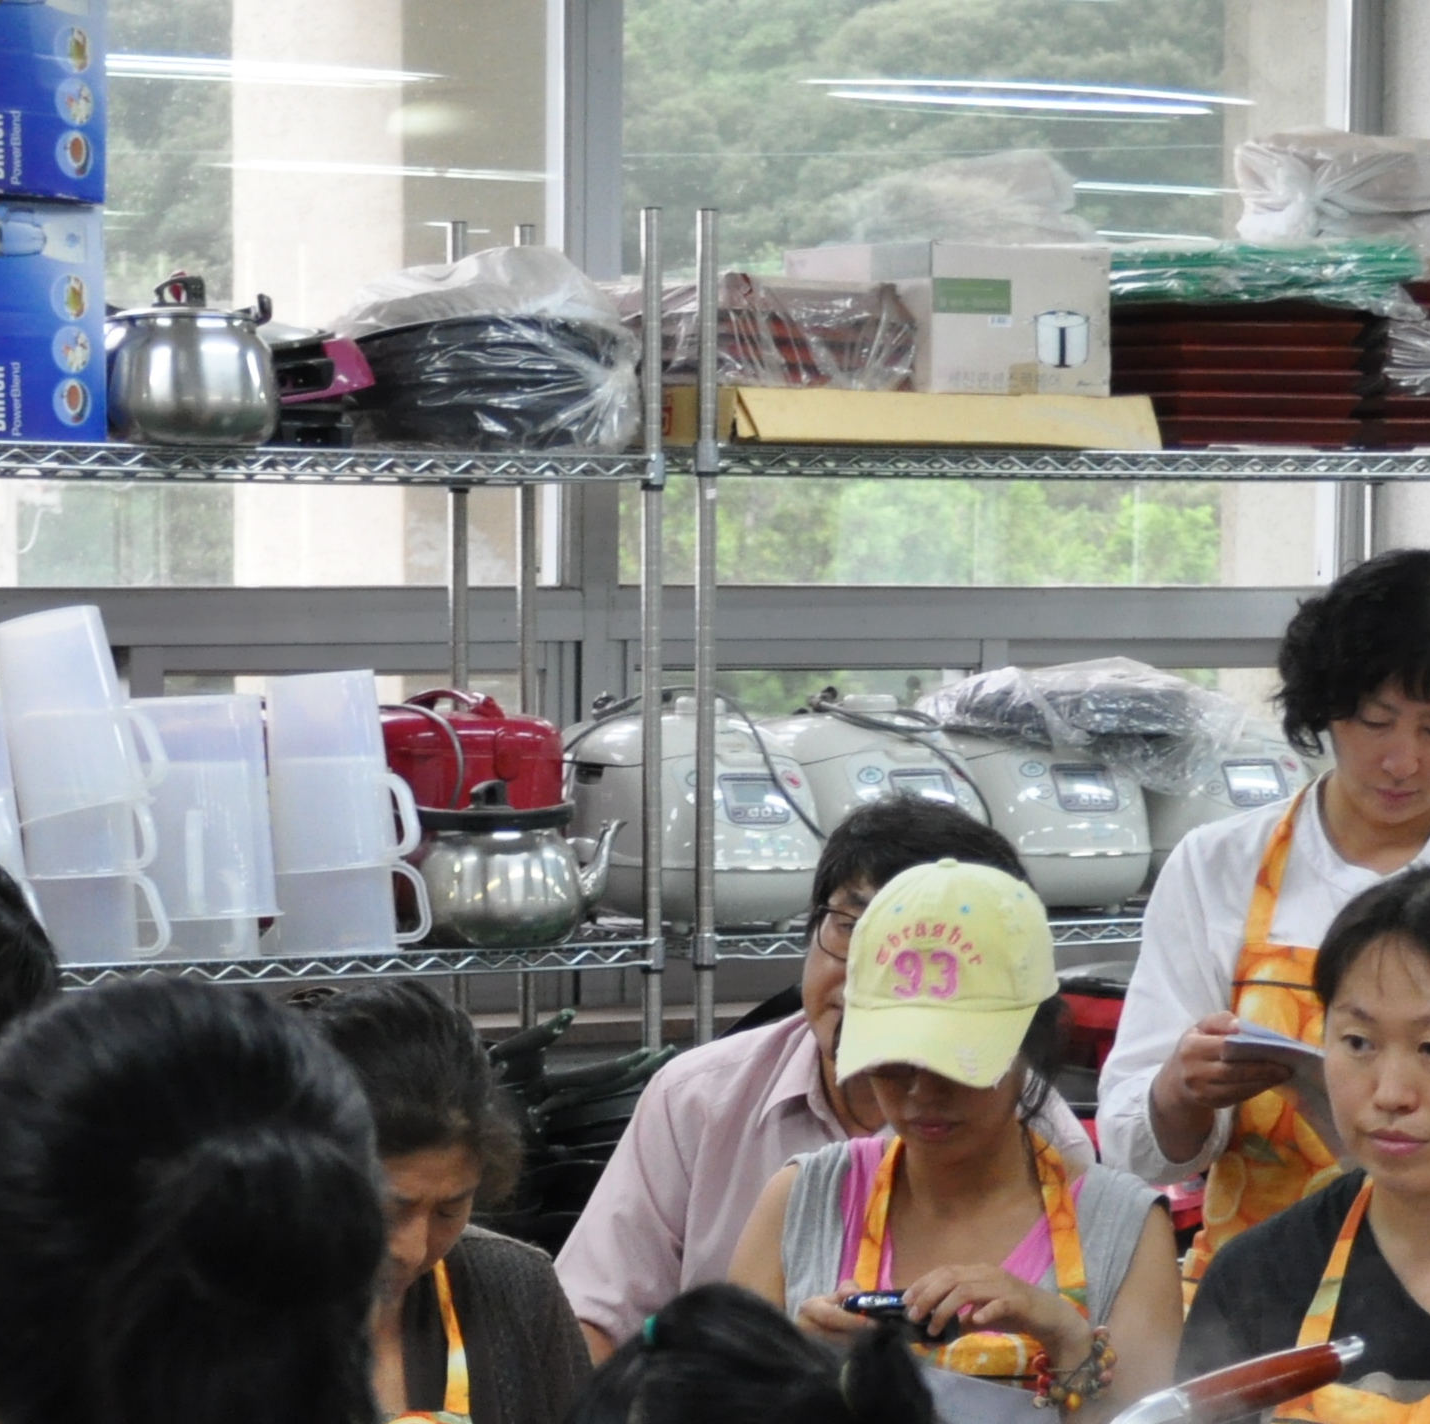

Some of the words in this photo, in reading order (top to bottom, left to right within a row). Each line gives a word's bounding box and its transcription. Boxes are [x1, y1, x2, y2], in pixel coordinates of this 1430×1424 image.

[9, 110, 22, 186] PowerBlend
[10, 361, 22, 437] PowerBlend
[875, 920, 984, 966] Thrasher
[892, 948, 960, 1000] 93
